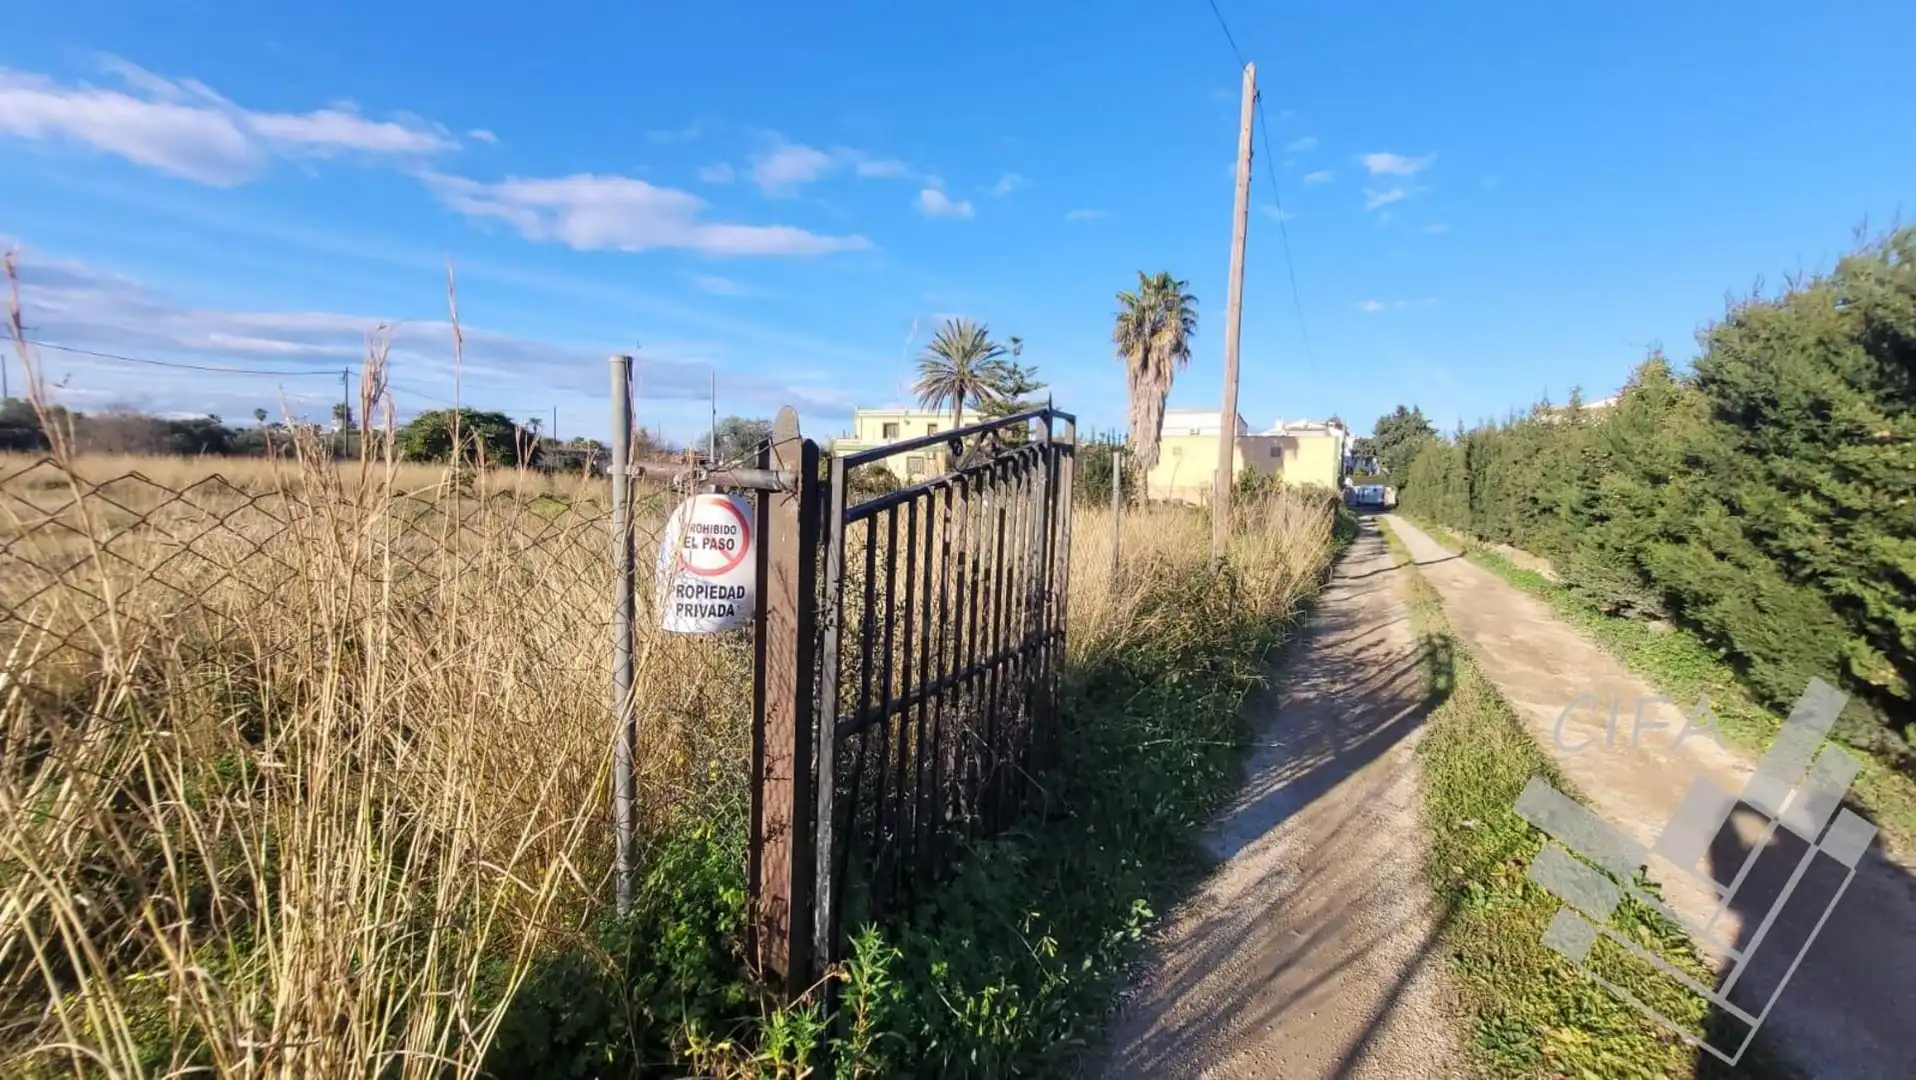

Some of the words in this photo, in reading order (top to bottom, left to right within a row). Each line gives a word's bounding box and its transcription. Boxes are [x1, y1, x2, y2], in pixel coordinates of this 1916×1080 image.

[685, 523, 737, 535] ROHIBIDO
[684, 535, 698, 549] EL
[702, 537, 735, 551] PASO
[676, 603, 735, 618] PRIVADA
